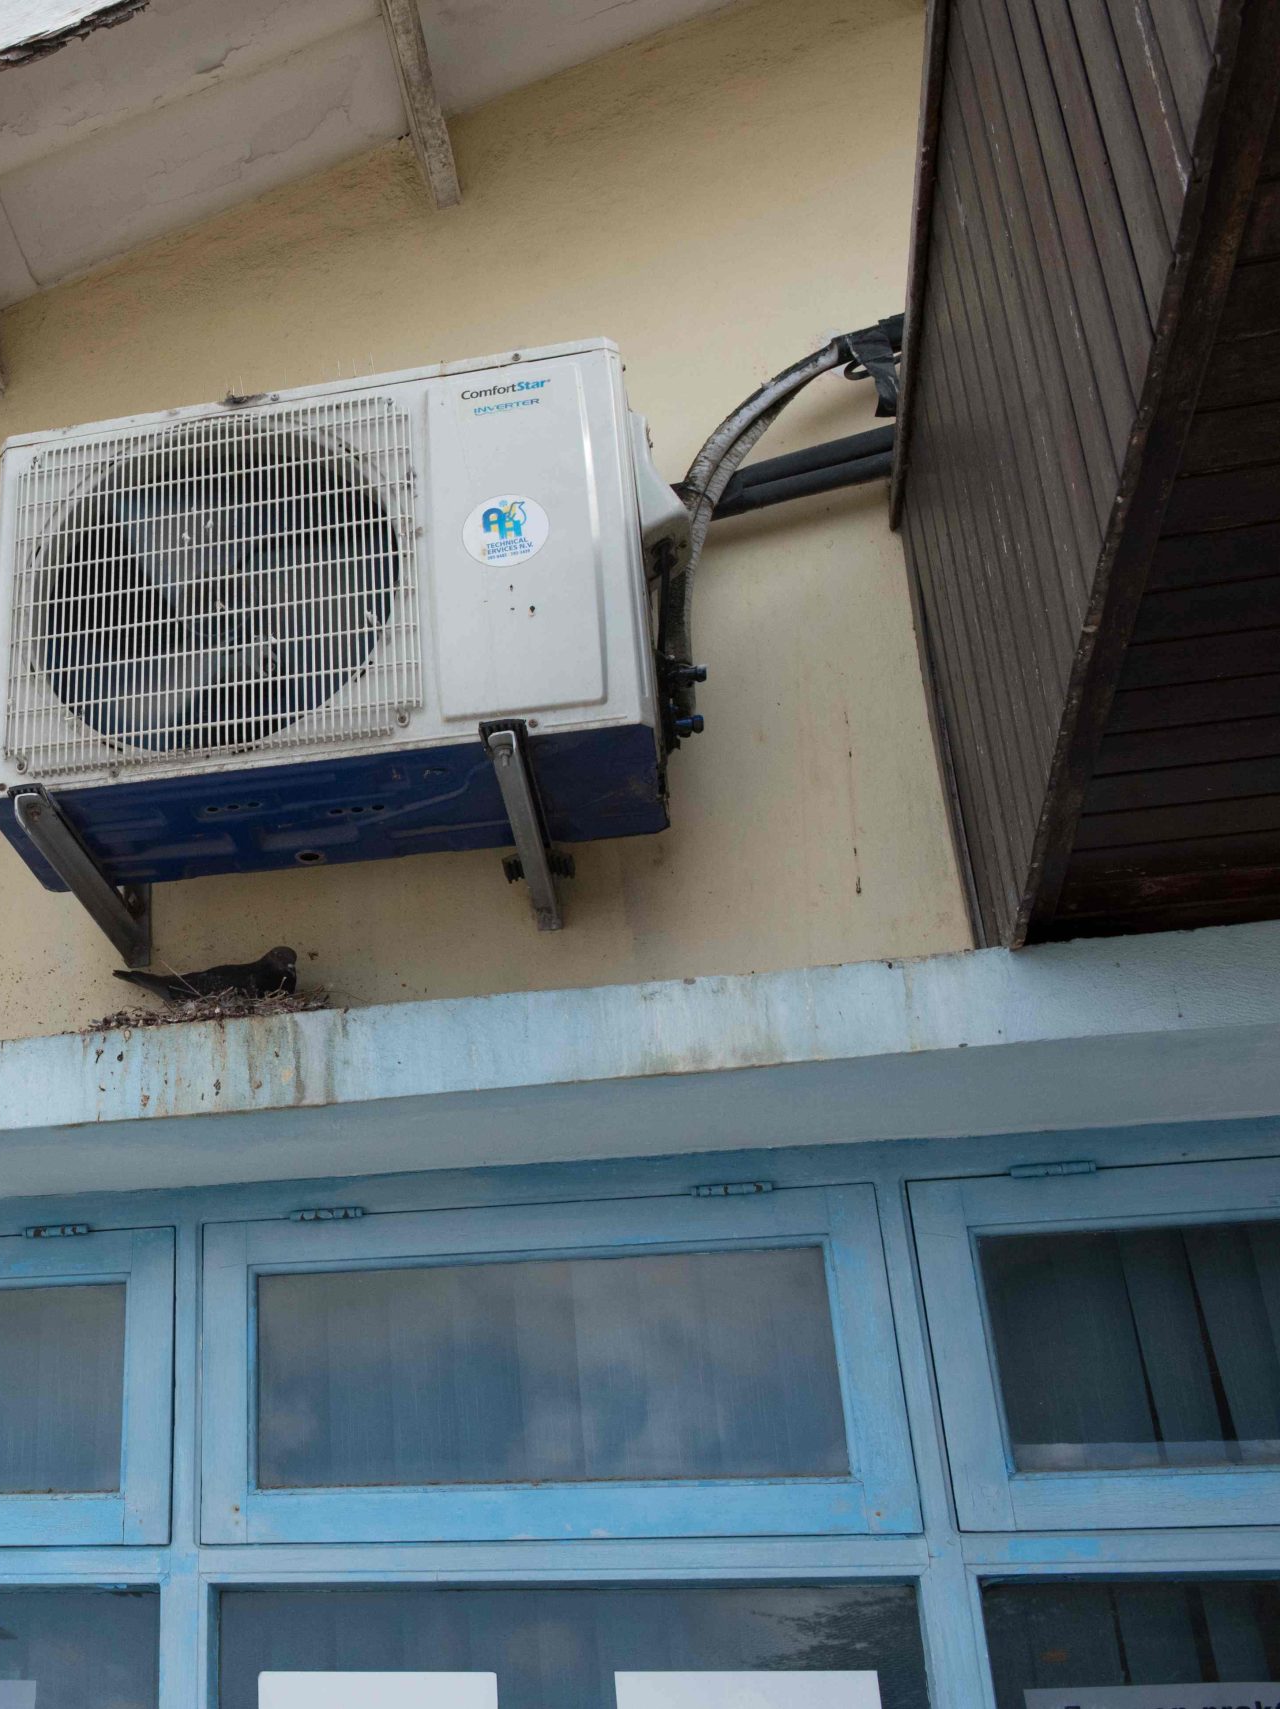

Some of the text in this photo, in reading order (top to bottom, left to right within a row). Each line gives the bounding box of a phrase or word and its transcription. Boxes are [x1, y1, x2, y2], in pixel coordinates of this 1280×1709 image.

[461, 379, 547, 401] ComfortStar
[474, 398, 540, 415] INVERTER
[485, 545, 518, 555] ERVICES
[486, 537, 529, 549] TECHNICAL
